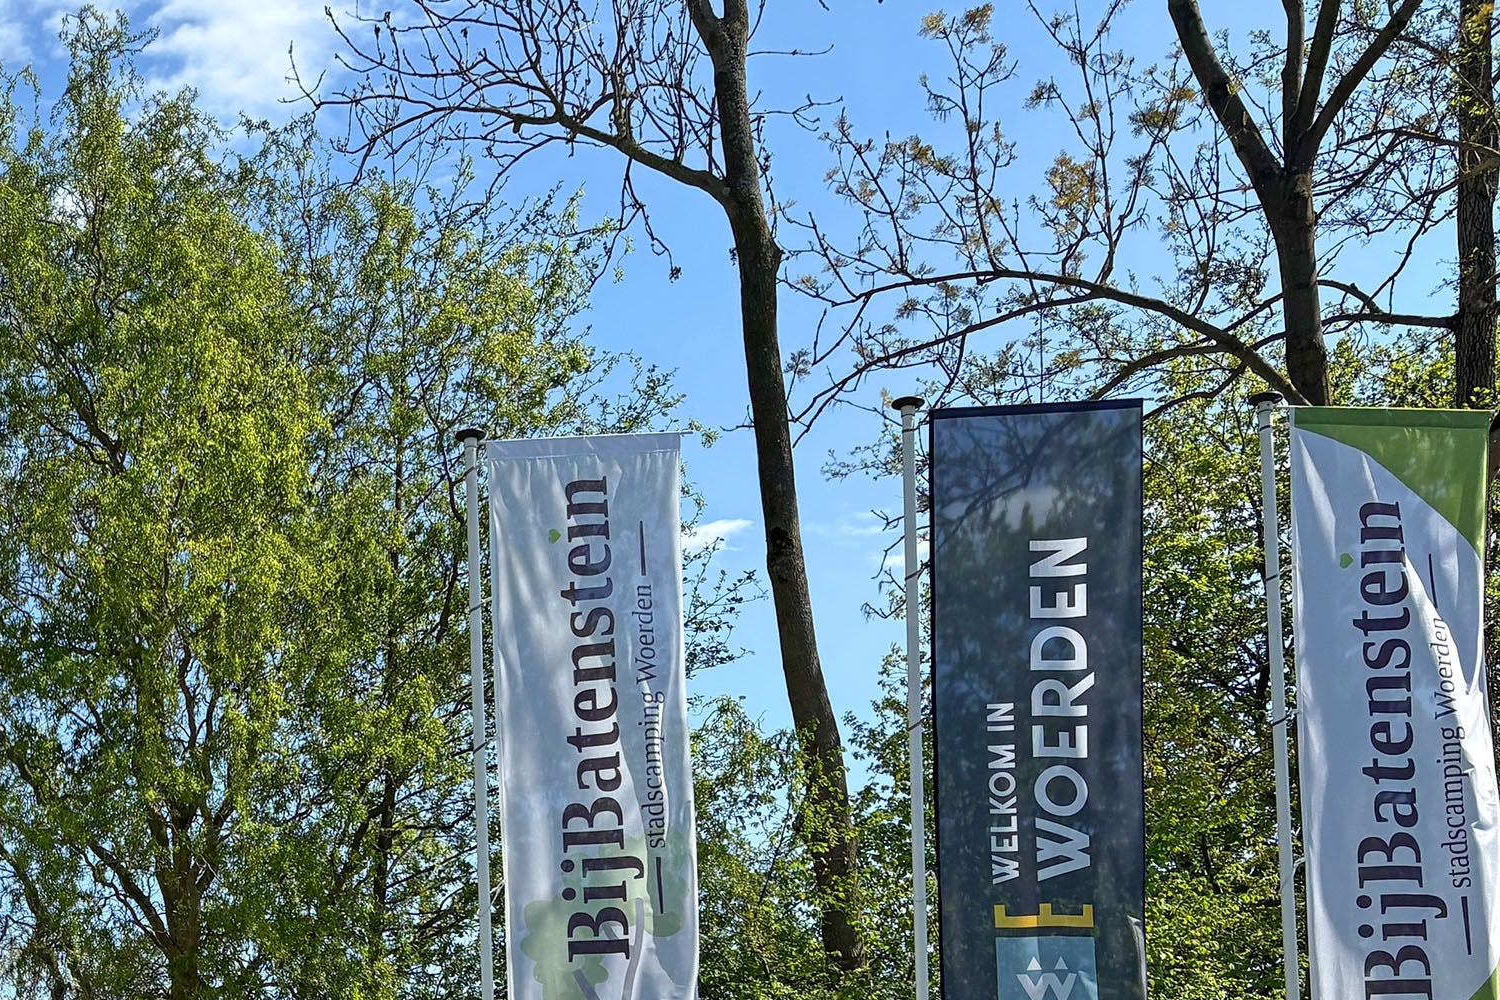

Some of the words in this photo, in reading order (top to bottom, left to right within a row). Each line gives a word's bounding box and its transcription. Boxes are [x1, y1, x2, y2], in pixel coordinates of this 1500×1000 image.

[632, 583, 657, 686] Woerden
[1029, 536, 1096, 882] WOERDEN
[1430, 617, 1457, 720] Woerden
[548, 475, 645, 963] BijBatenstein
[636, 691, 666, 848] stadscamping
[986, 702, 1015, 732] IN
[987, 744, 1020, 885] WELKOM
[1436, 725, 1472, 888] stadscamping
